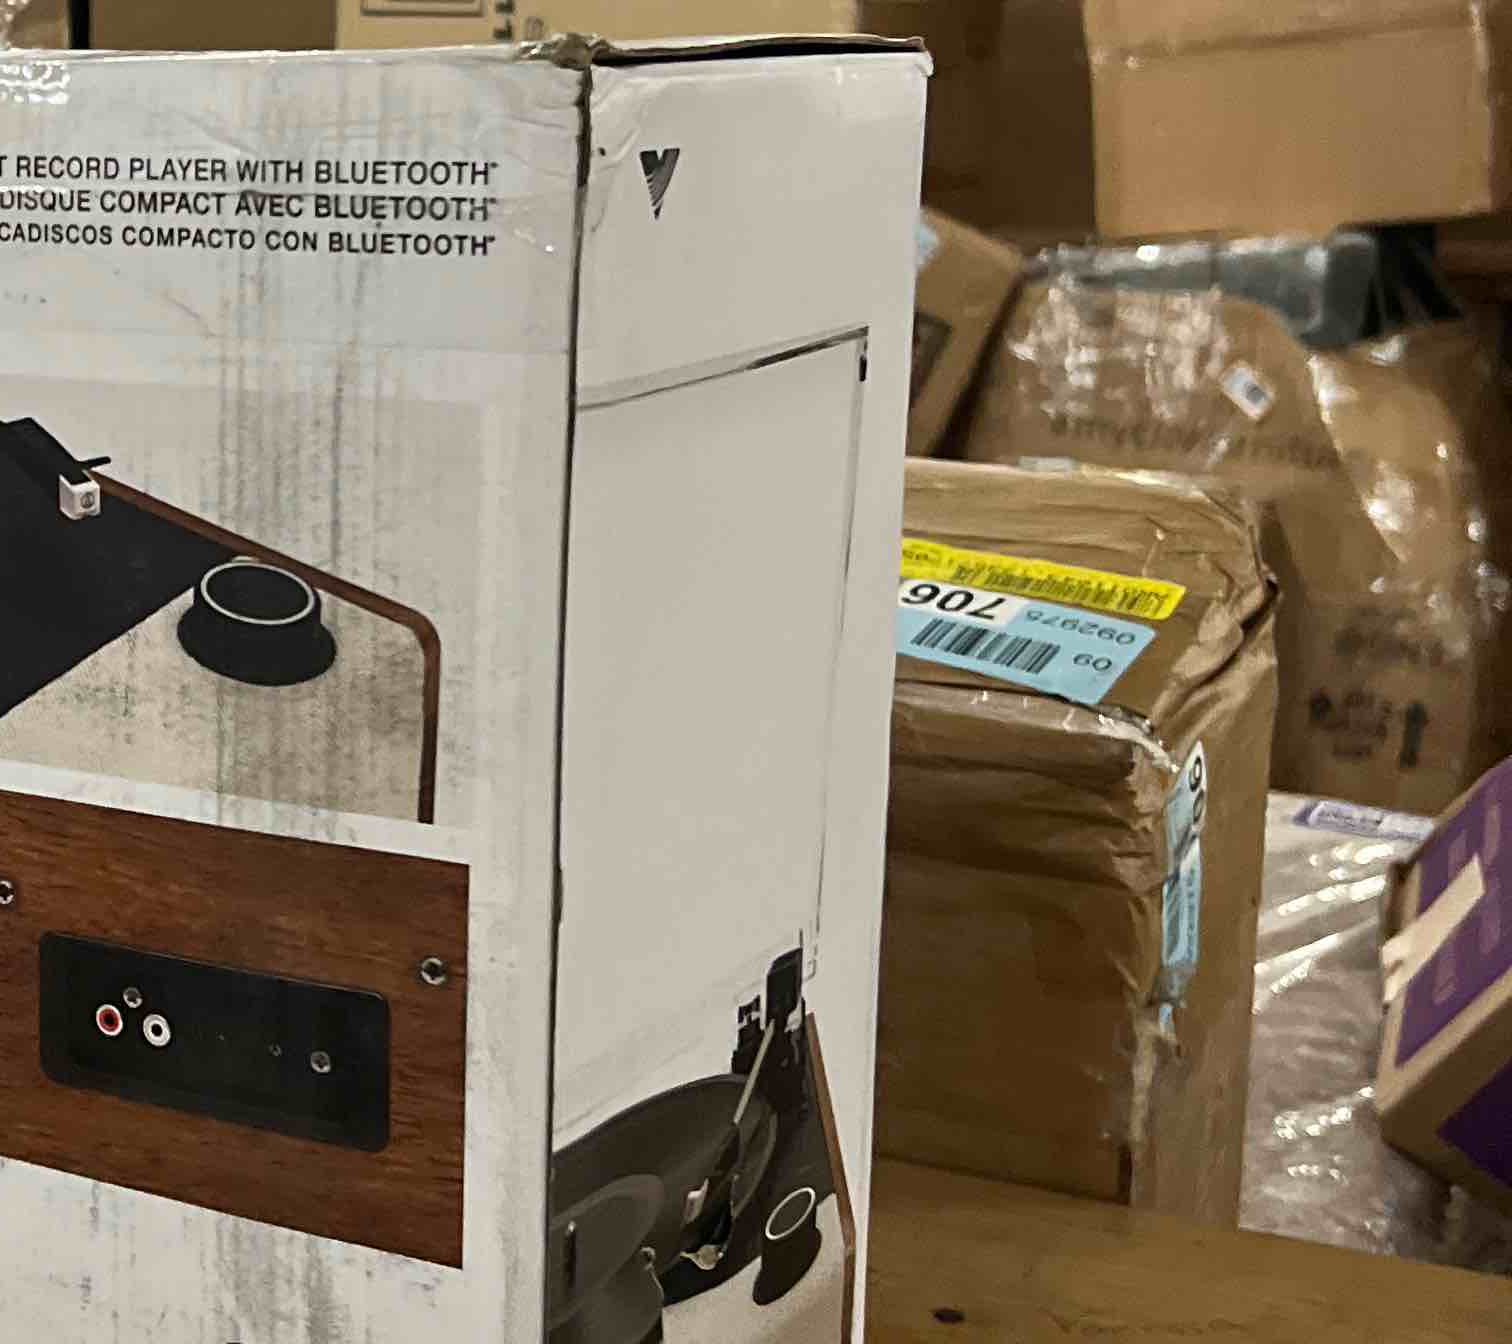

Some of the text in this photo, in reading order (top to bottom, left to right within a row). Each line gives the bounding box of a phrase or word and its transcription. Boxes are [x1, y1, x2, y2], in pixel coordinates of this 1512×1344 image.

[16, 155, 119, 179] RECORD
[129, 158, 227, 183] PLAYER
[238, 160, 303, 183] WITH
[100, 190, 226, 215] COMPACT
[235, 193, 303, 218] AVEC
[122, 225, 254, 249] COMPACTO
[265, 230, 317, 251] CON
[902, 583, 1005, 620] 706
